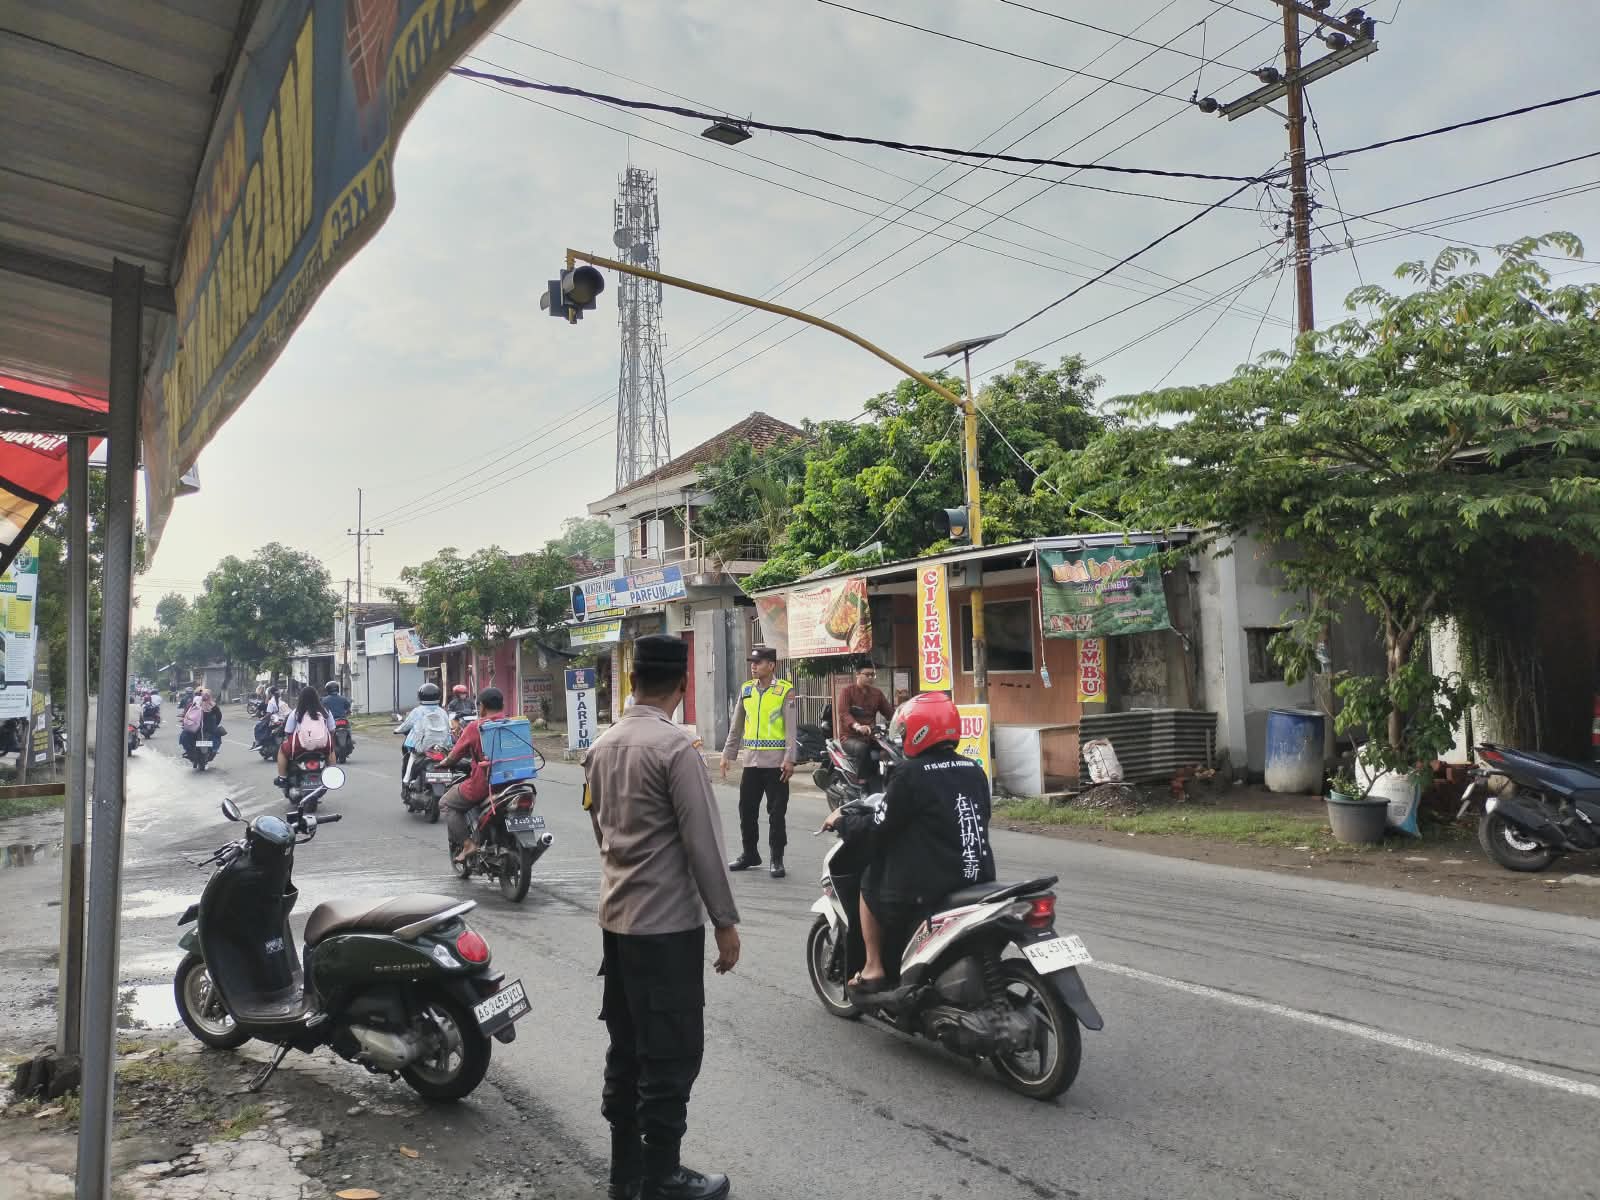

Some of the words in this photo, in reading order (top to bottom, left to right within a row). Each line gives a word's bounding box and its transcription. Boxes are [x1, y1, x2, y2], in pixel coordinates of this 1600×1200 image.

[630, 585, 668, 603] PARFUM
[922, 570, 942, 683] CILEMBU
[577, 692, 590, 749] PARFUM
